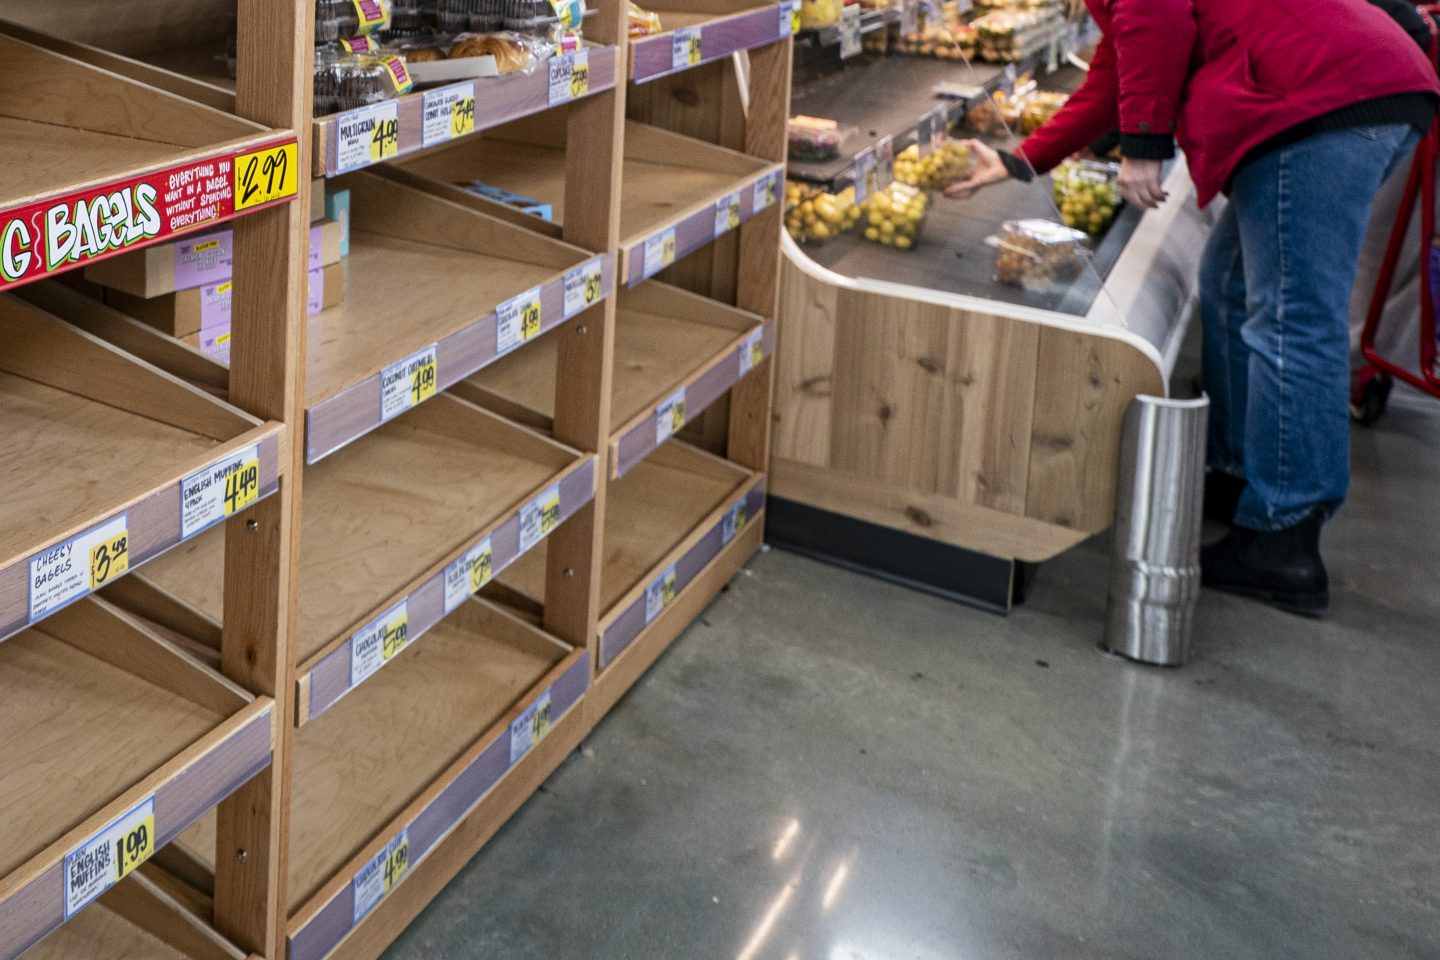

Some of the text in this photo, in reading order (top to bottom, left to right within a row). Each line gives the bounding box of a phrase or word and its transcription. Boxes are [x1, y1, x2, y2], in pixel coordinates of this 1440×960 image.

[340, 117, 376, 141] MULTIGRAIN
[219, 161, 230, 173] YOU
[164, 189, 186, 203] WANT
[187, 184, 195, 195] IN
[196, 183, 202, 194] A
[166, 187, 233, 217] WITHOUT SPENDING
[383, 366, 407, 388] COCONUT
[184, 459, 244, 501] ENGLISH MUFFINS
[35, 559, 72, 589] BAGELS
[70, 839, 110, 880] ENGLISH
[70, 853, 111, 893] MUFFINS
